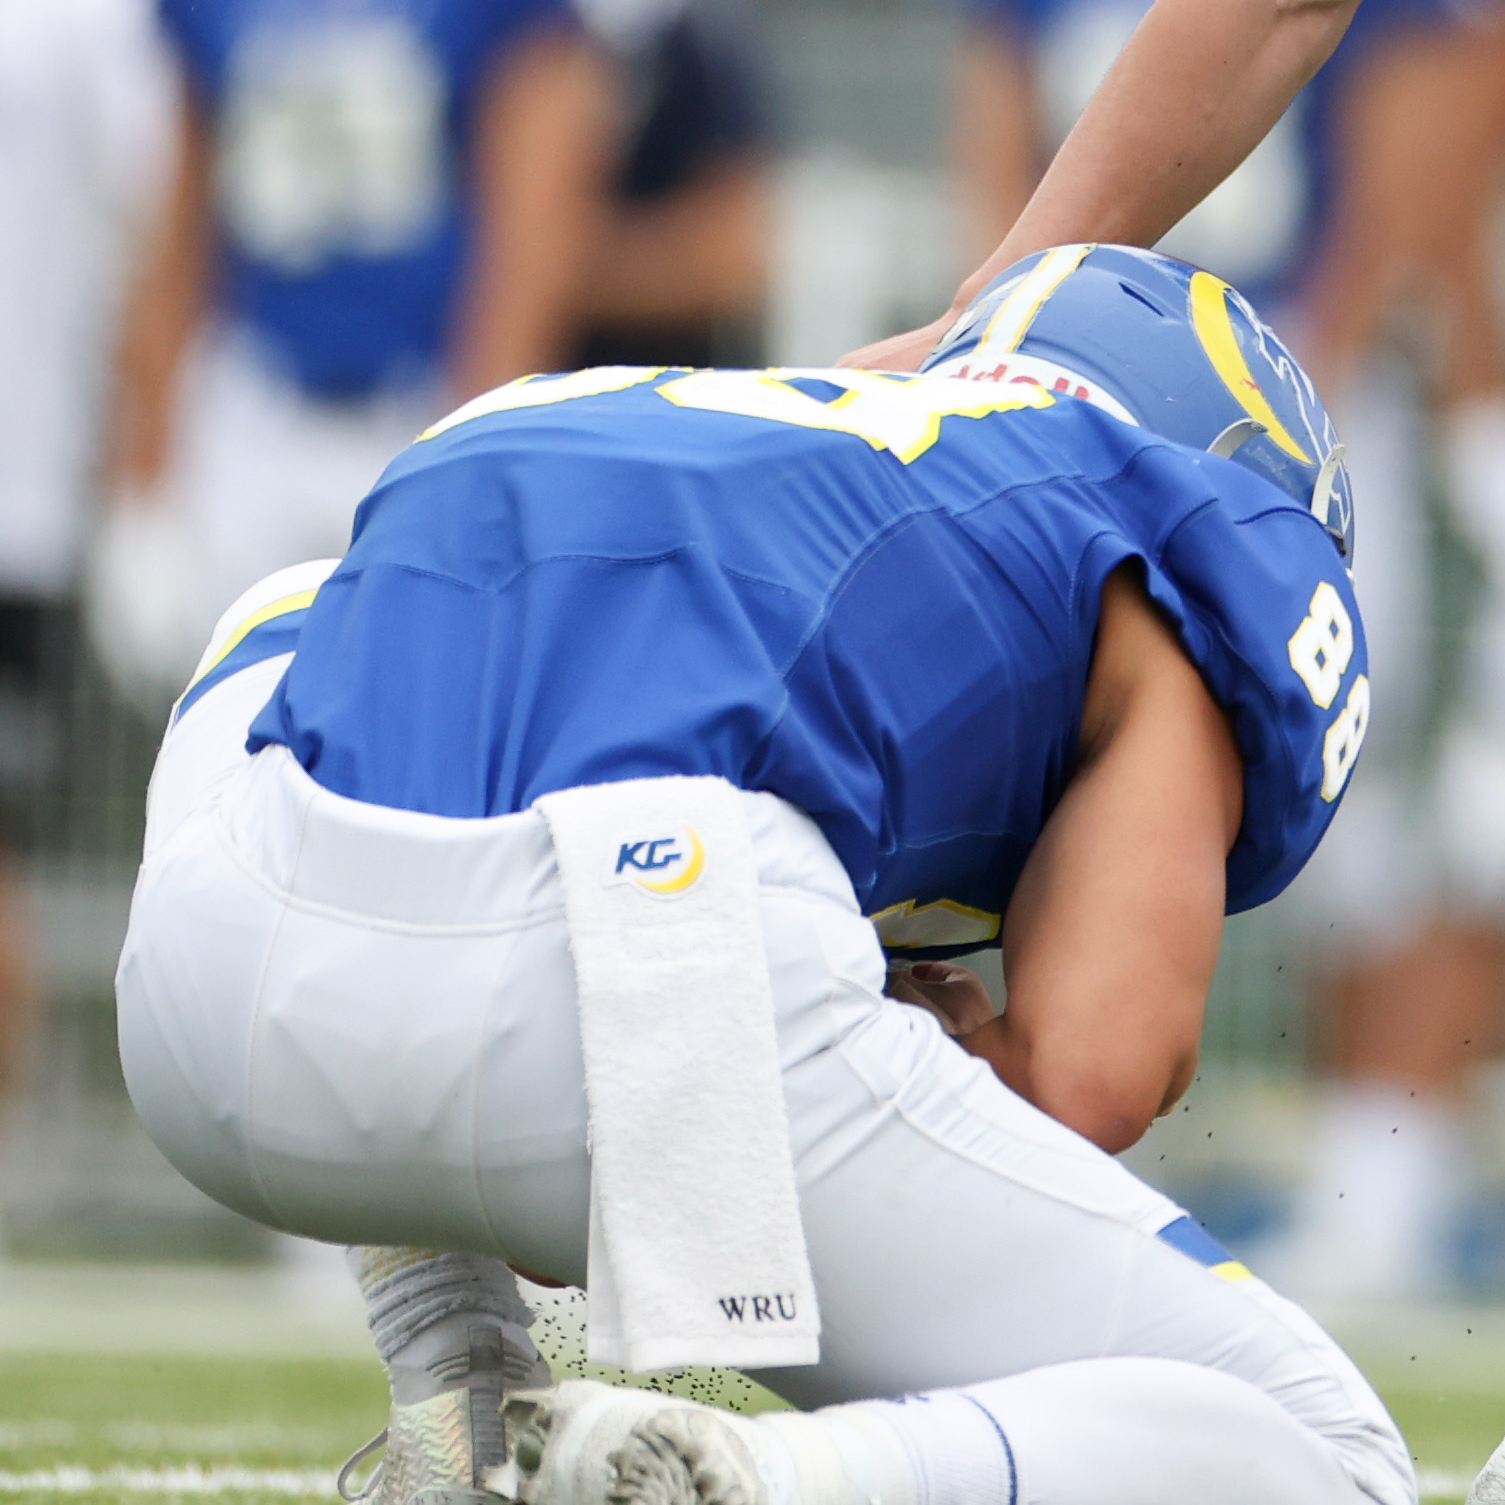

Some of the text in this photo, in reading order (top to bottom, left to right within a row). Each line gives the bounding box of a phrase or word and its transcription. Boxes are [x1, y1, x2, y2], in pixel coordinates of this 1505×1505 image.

[1287, 580, 1371, 803] 88
[614, 837, 682, 874] KG
[718, 1293, 796, 1324] WRU
